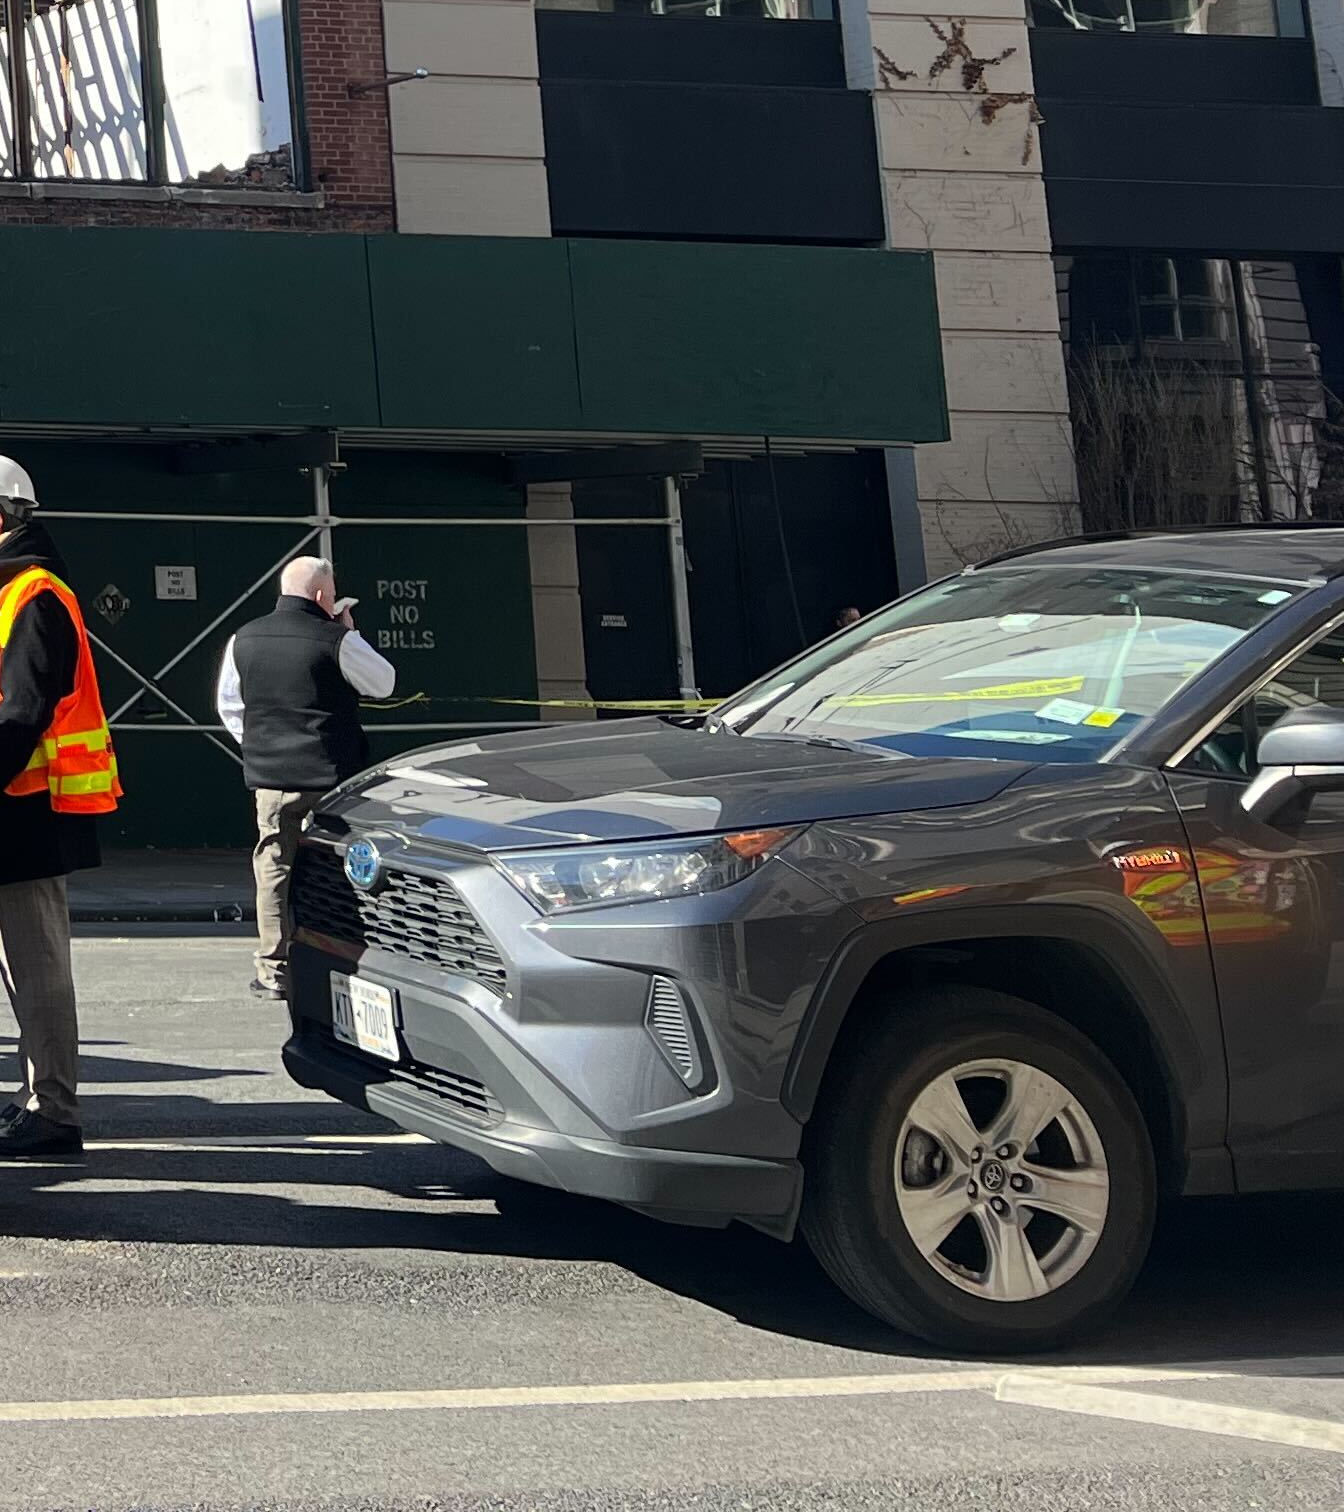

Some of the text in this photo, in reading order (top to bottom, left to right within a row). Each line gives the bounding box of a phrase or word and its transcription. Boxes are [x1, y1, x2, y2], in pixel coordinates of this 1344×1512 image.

[376, 579, 429, 600] POST
[390, 605, 419, 624] NO
[377, 629, 436, 649] BILLS
